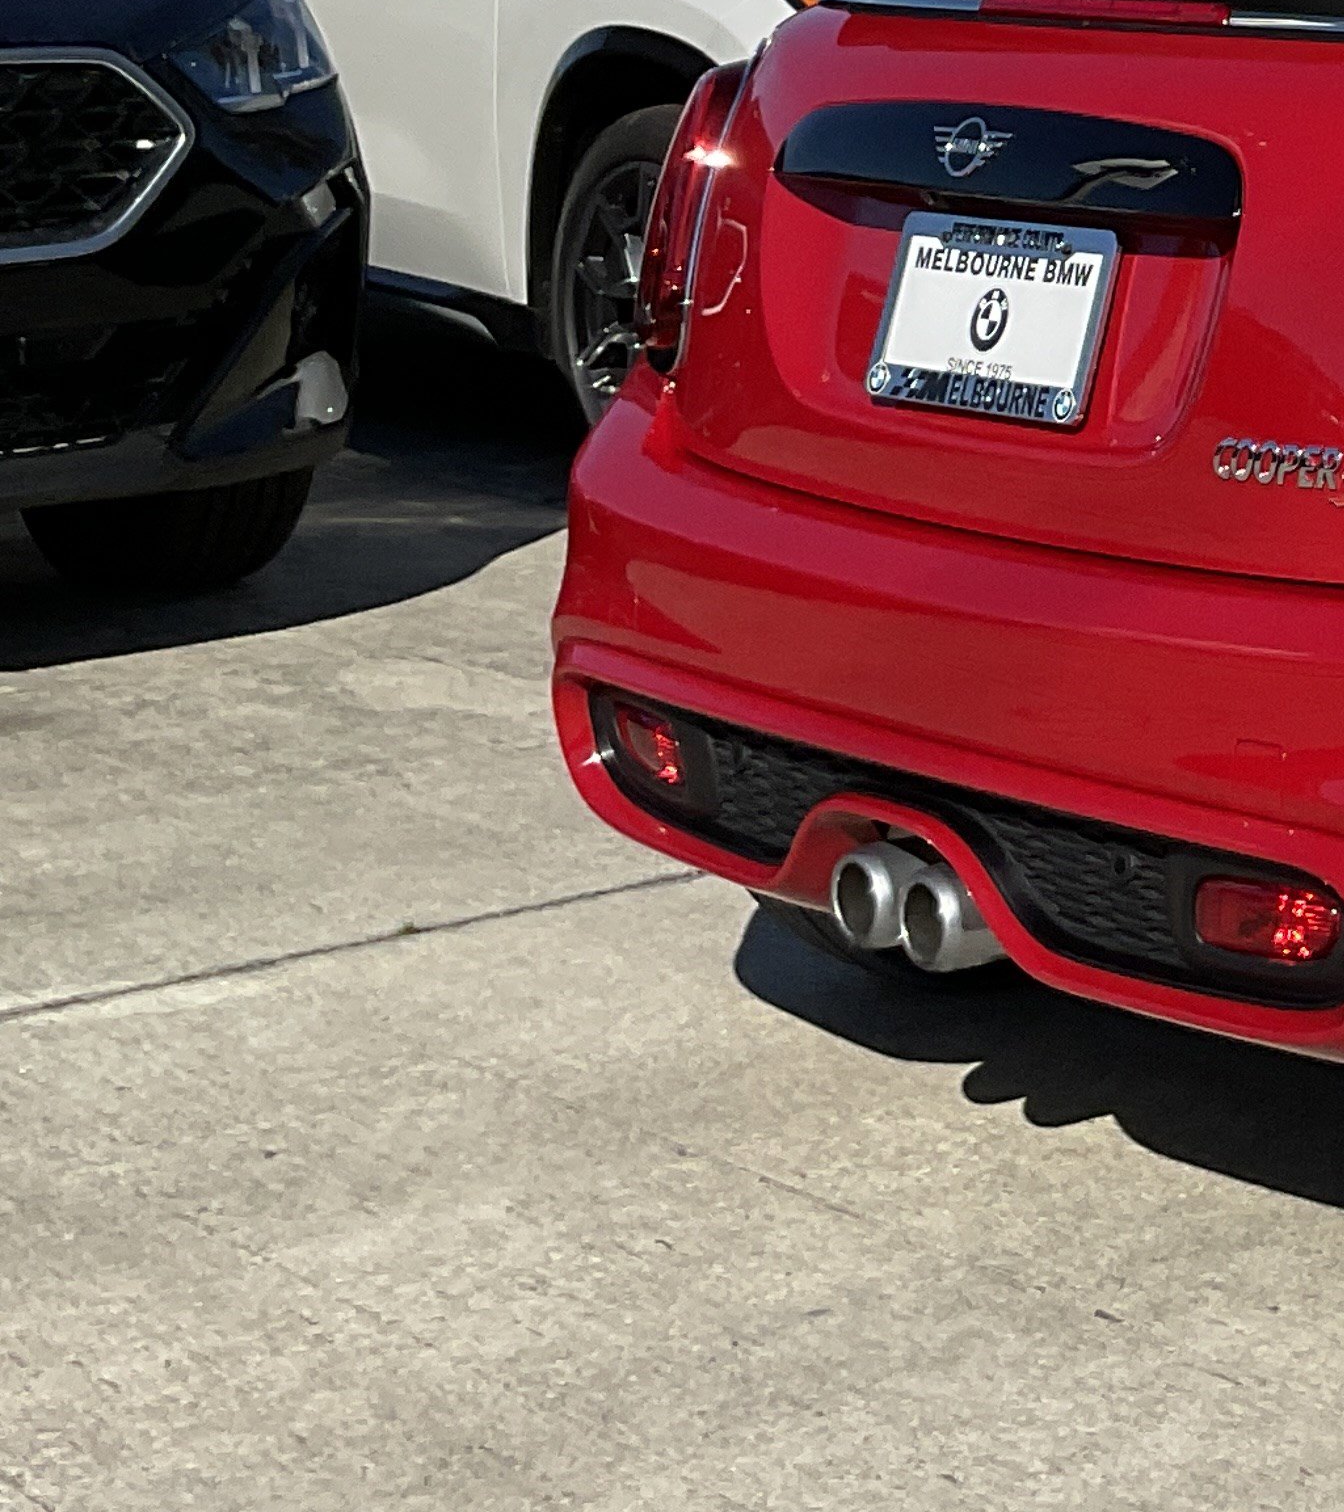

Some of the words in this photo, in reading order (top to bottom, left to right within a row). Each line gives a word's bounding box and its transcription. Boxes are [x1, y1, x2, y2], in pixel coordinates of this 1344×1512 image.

[915, 246, 1039, 282] MELBOURNE
[1043, 257, 1094, 287] BMW
[946, 356, 982, 377] SINCE
[986, 362, 1013, 379] 1975
[1213, 437, 1343, 490] COOPER
